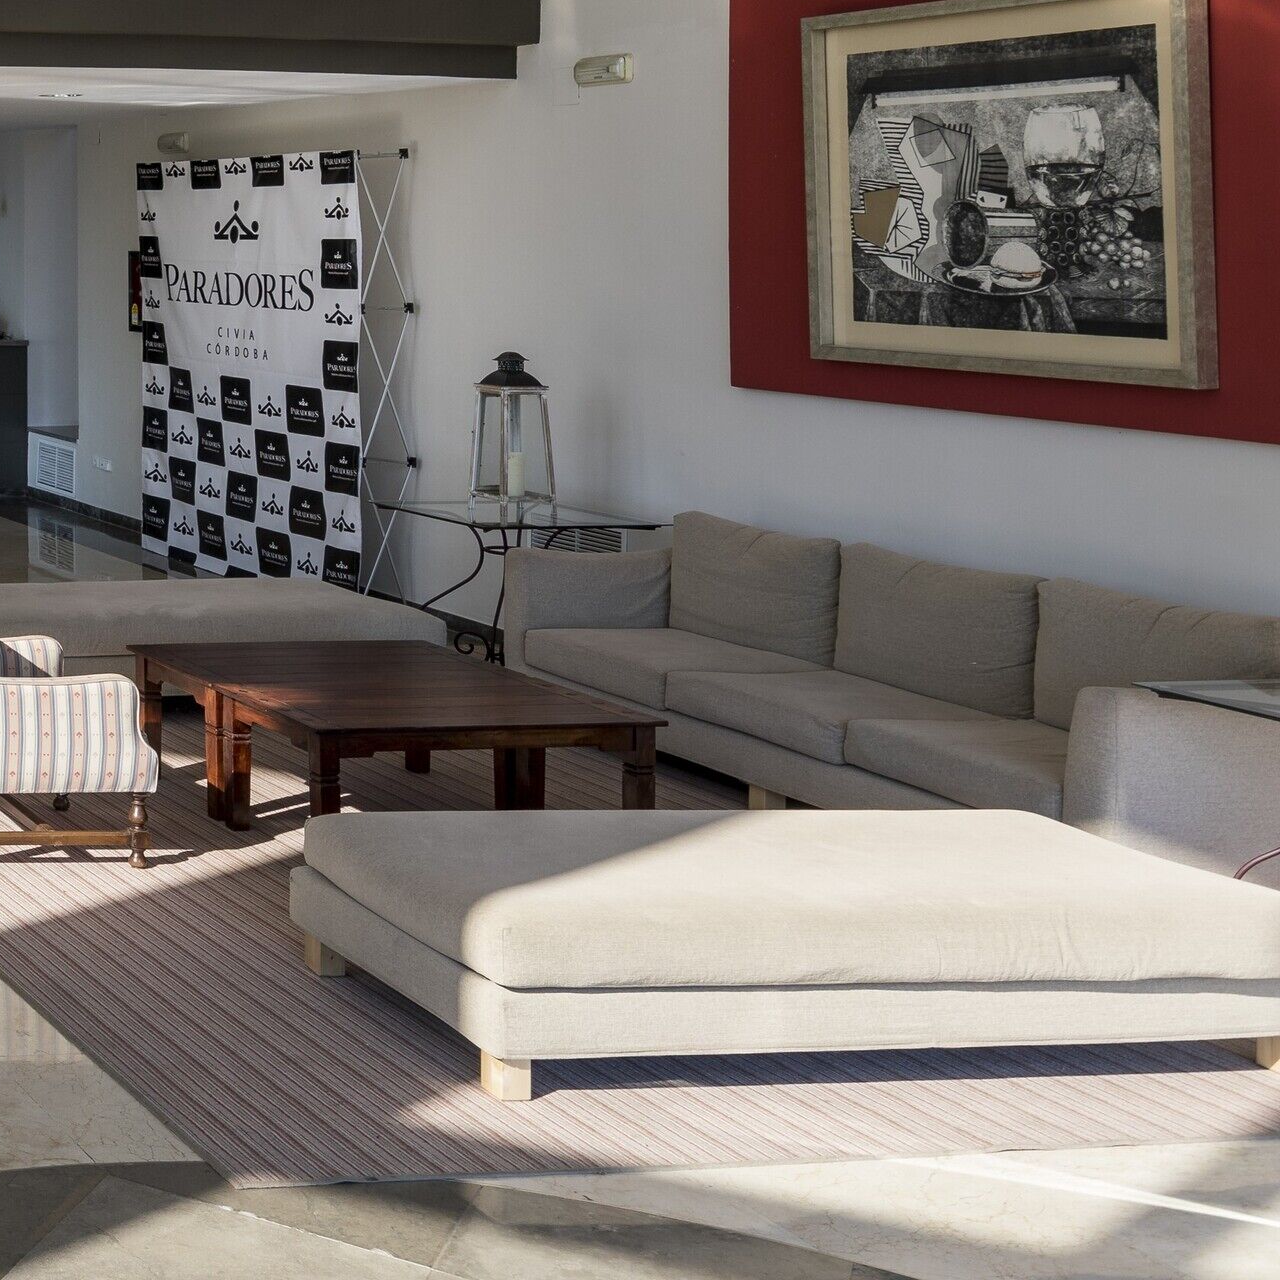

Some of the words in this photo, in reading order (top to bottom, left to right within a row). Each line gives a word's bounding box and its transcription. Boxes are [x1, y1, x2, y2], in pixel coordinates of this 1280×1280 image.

[163, 263, 315, 312] PARADORES
[217, 326, 256, 341] CIVIA
[206, 342, 269, 361] CÓRDOBA
